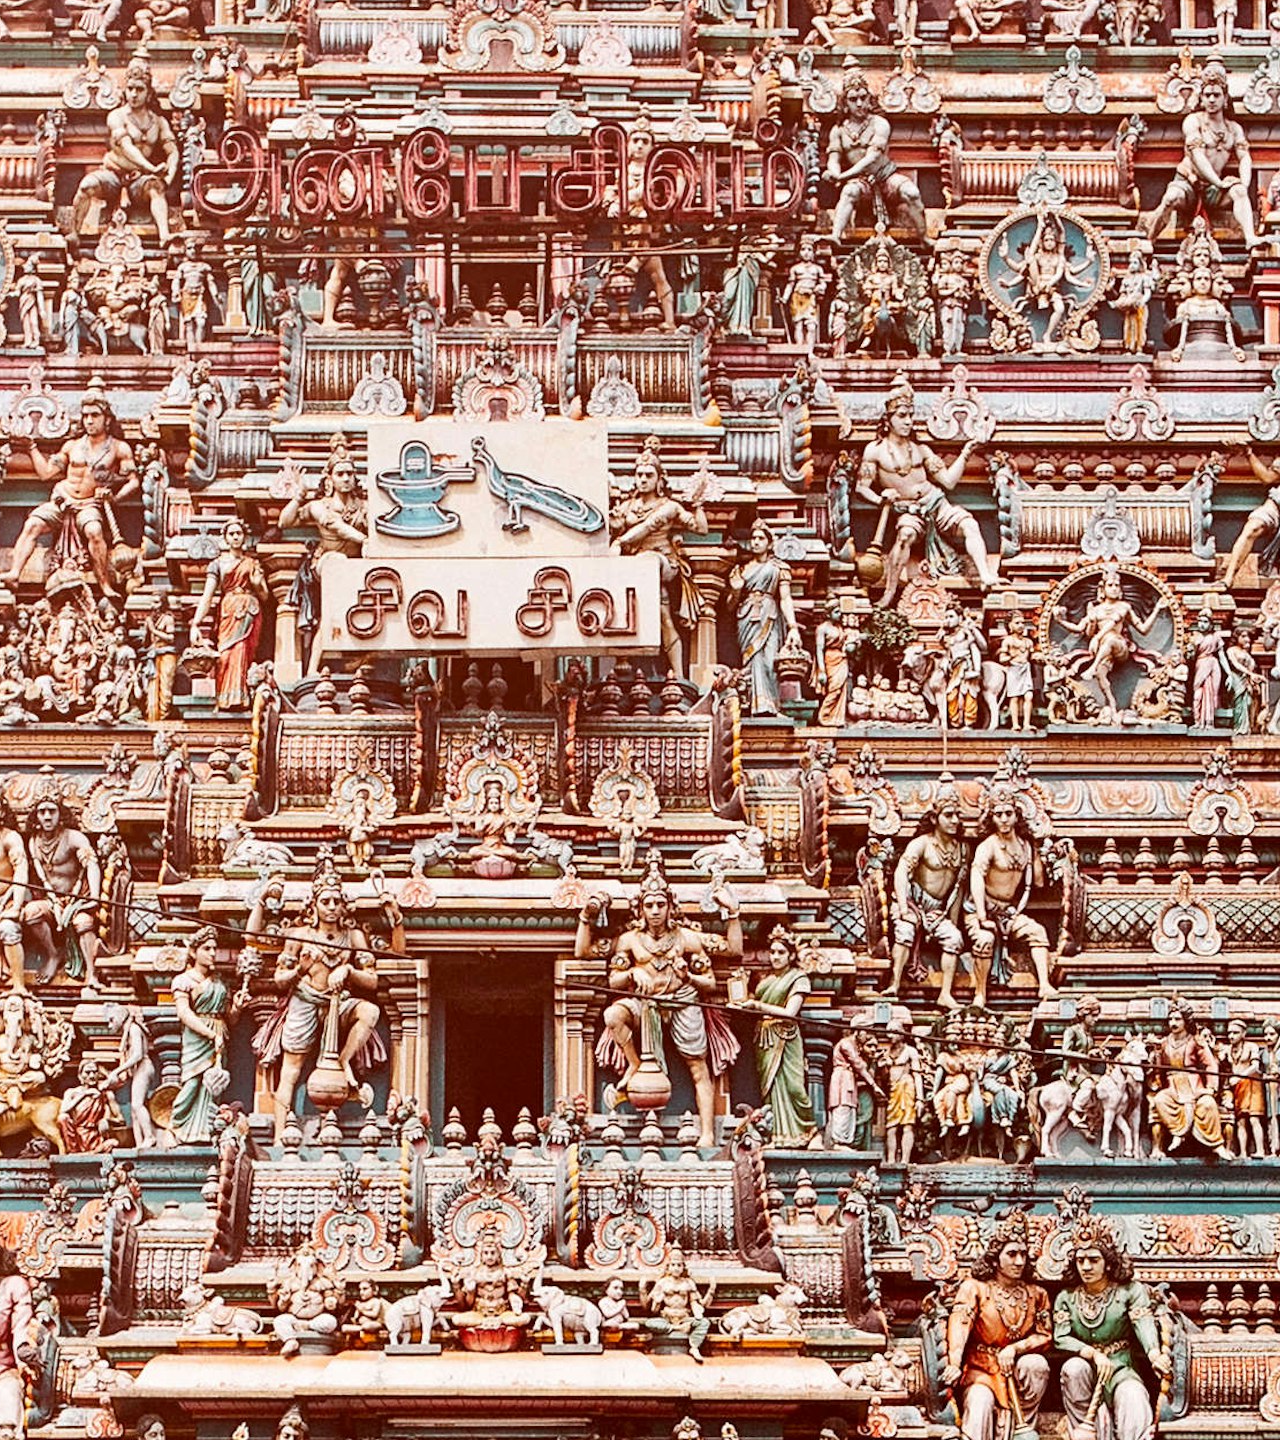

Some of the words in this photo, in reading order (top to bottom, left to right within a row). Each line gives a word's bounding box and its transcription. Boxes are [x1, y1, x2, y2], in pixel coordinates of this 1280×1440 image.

[190, 113, 523, 220] அன்பே
[551, 115, 808, 217] சிவம்
[345, 565, 469, 640] சிவ
[515, 565, 637, 638] சிவ
